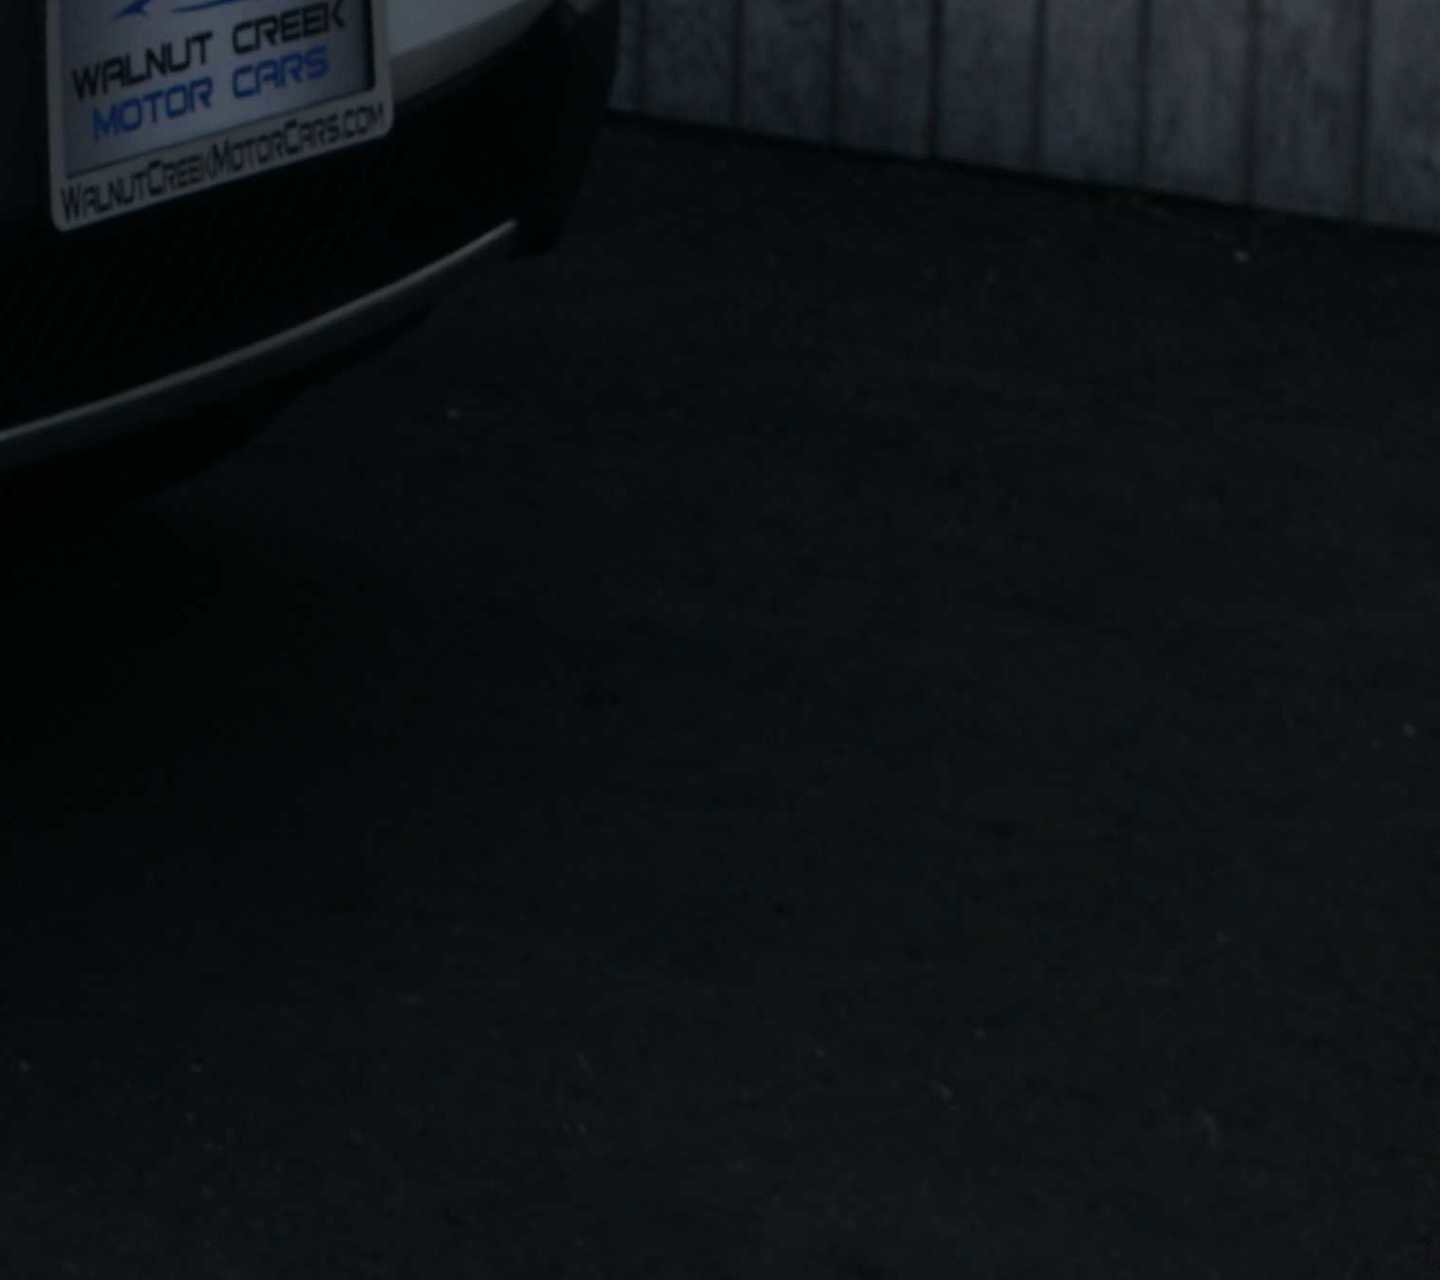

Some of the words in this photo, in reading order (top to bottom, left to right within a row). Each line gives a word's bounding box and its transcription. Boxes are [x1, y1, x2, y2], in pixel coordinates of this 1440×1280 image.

[71, 31, 213, 101] WALNUT
[91, 76, 214, 141] MOTOR
[232, 44, 330, 99] CARS
